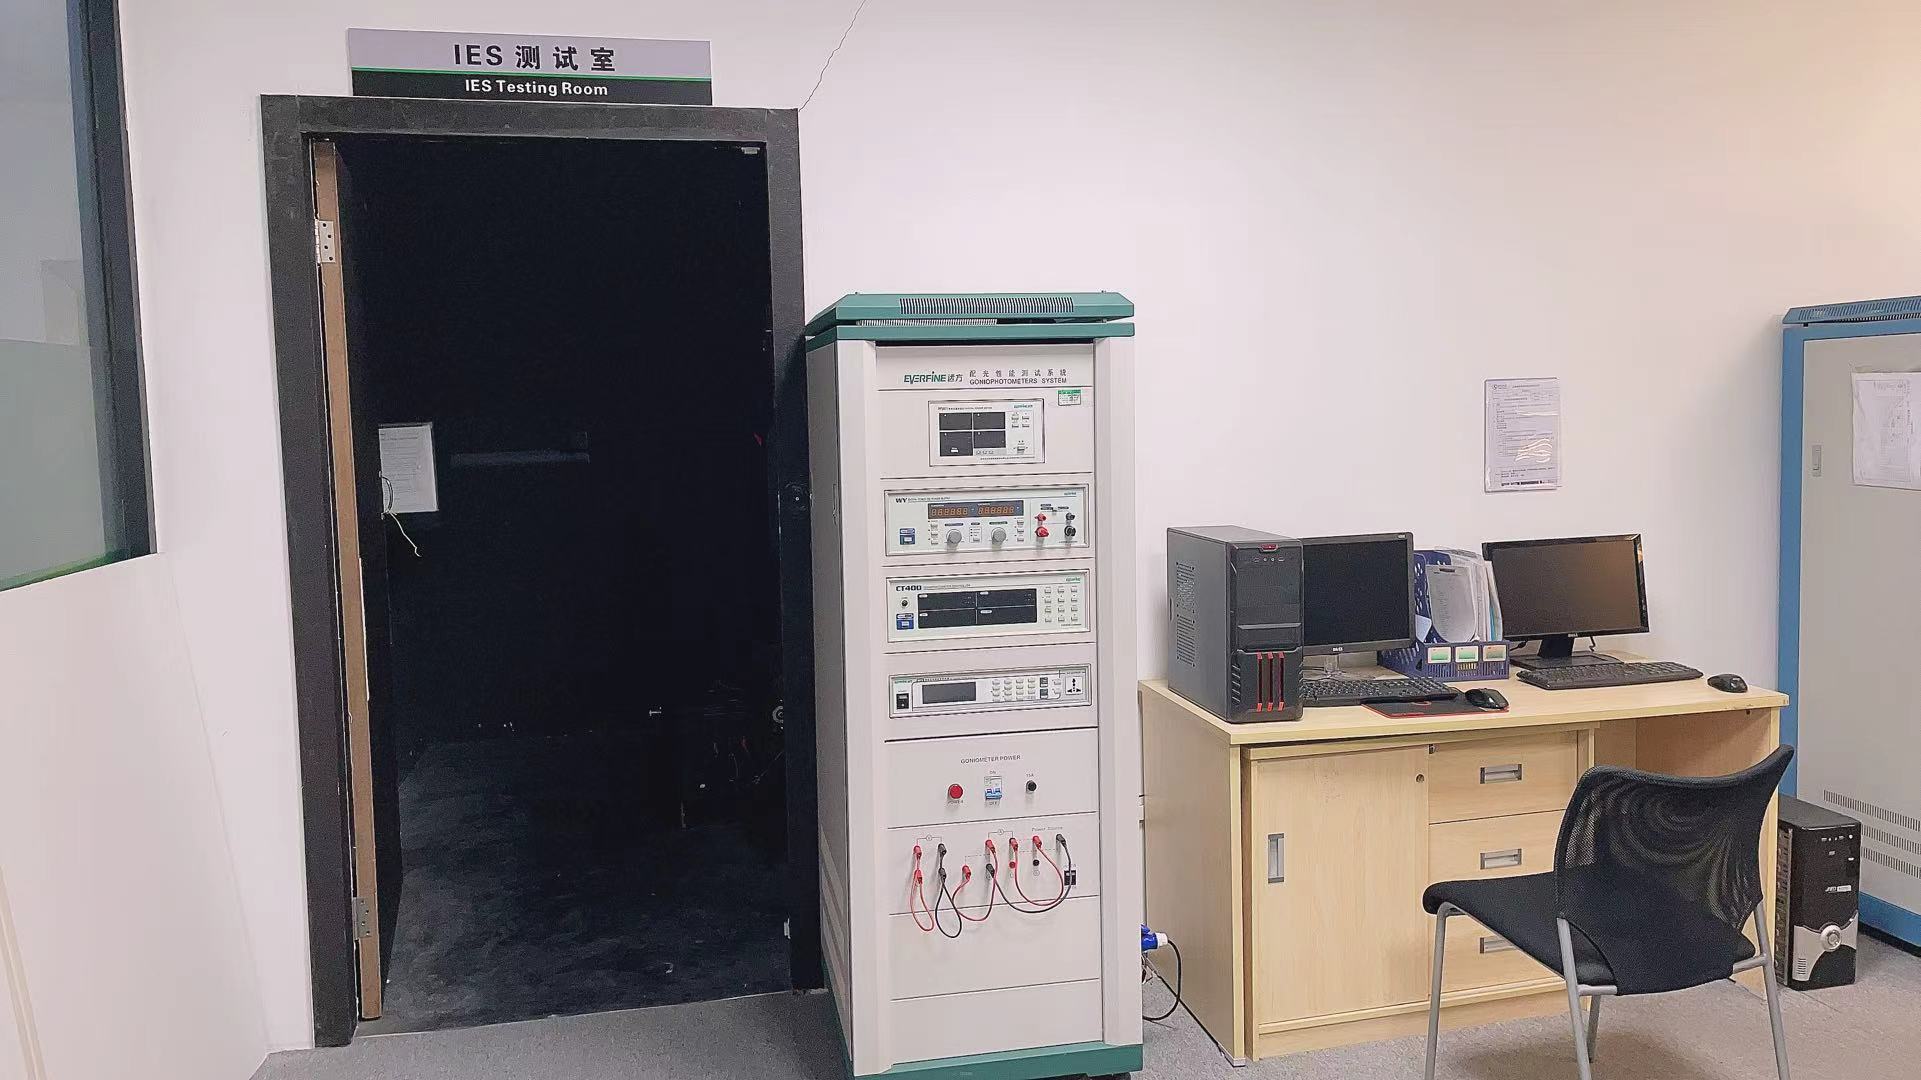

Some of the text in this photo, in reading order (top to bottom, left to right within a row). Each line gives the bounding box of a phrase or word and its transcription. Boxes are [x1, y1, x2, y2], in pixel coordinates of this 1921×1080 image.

[454, 44, 615, 72] IES 测试室
[465, 79, 608, 96] IES Testing Room
[969, 377, 1038, 385] GONIOPHOTOMETERS
[895, 584, 922, 592] CT400
